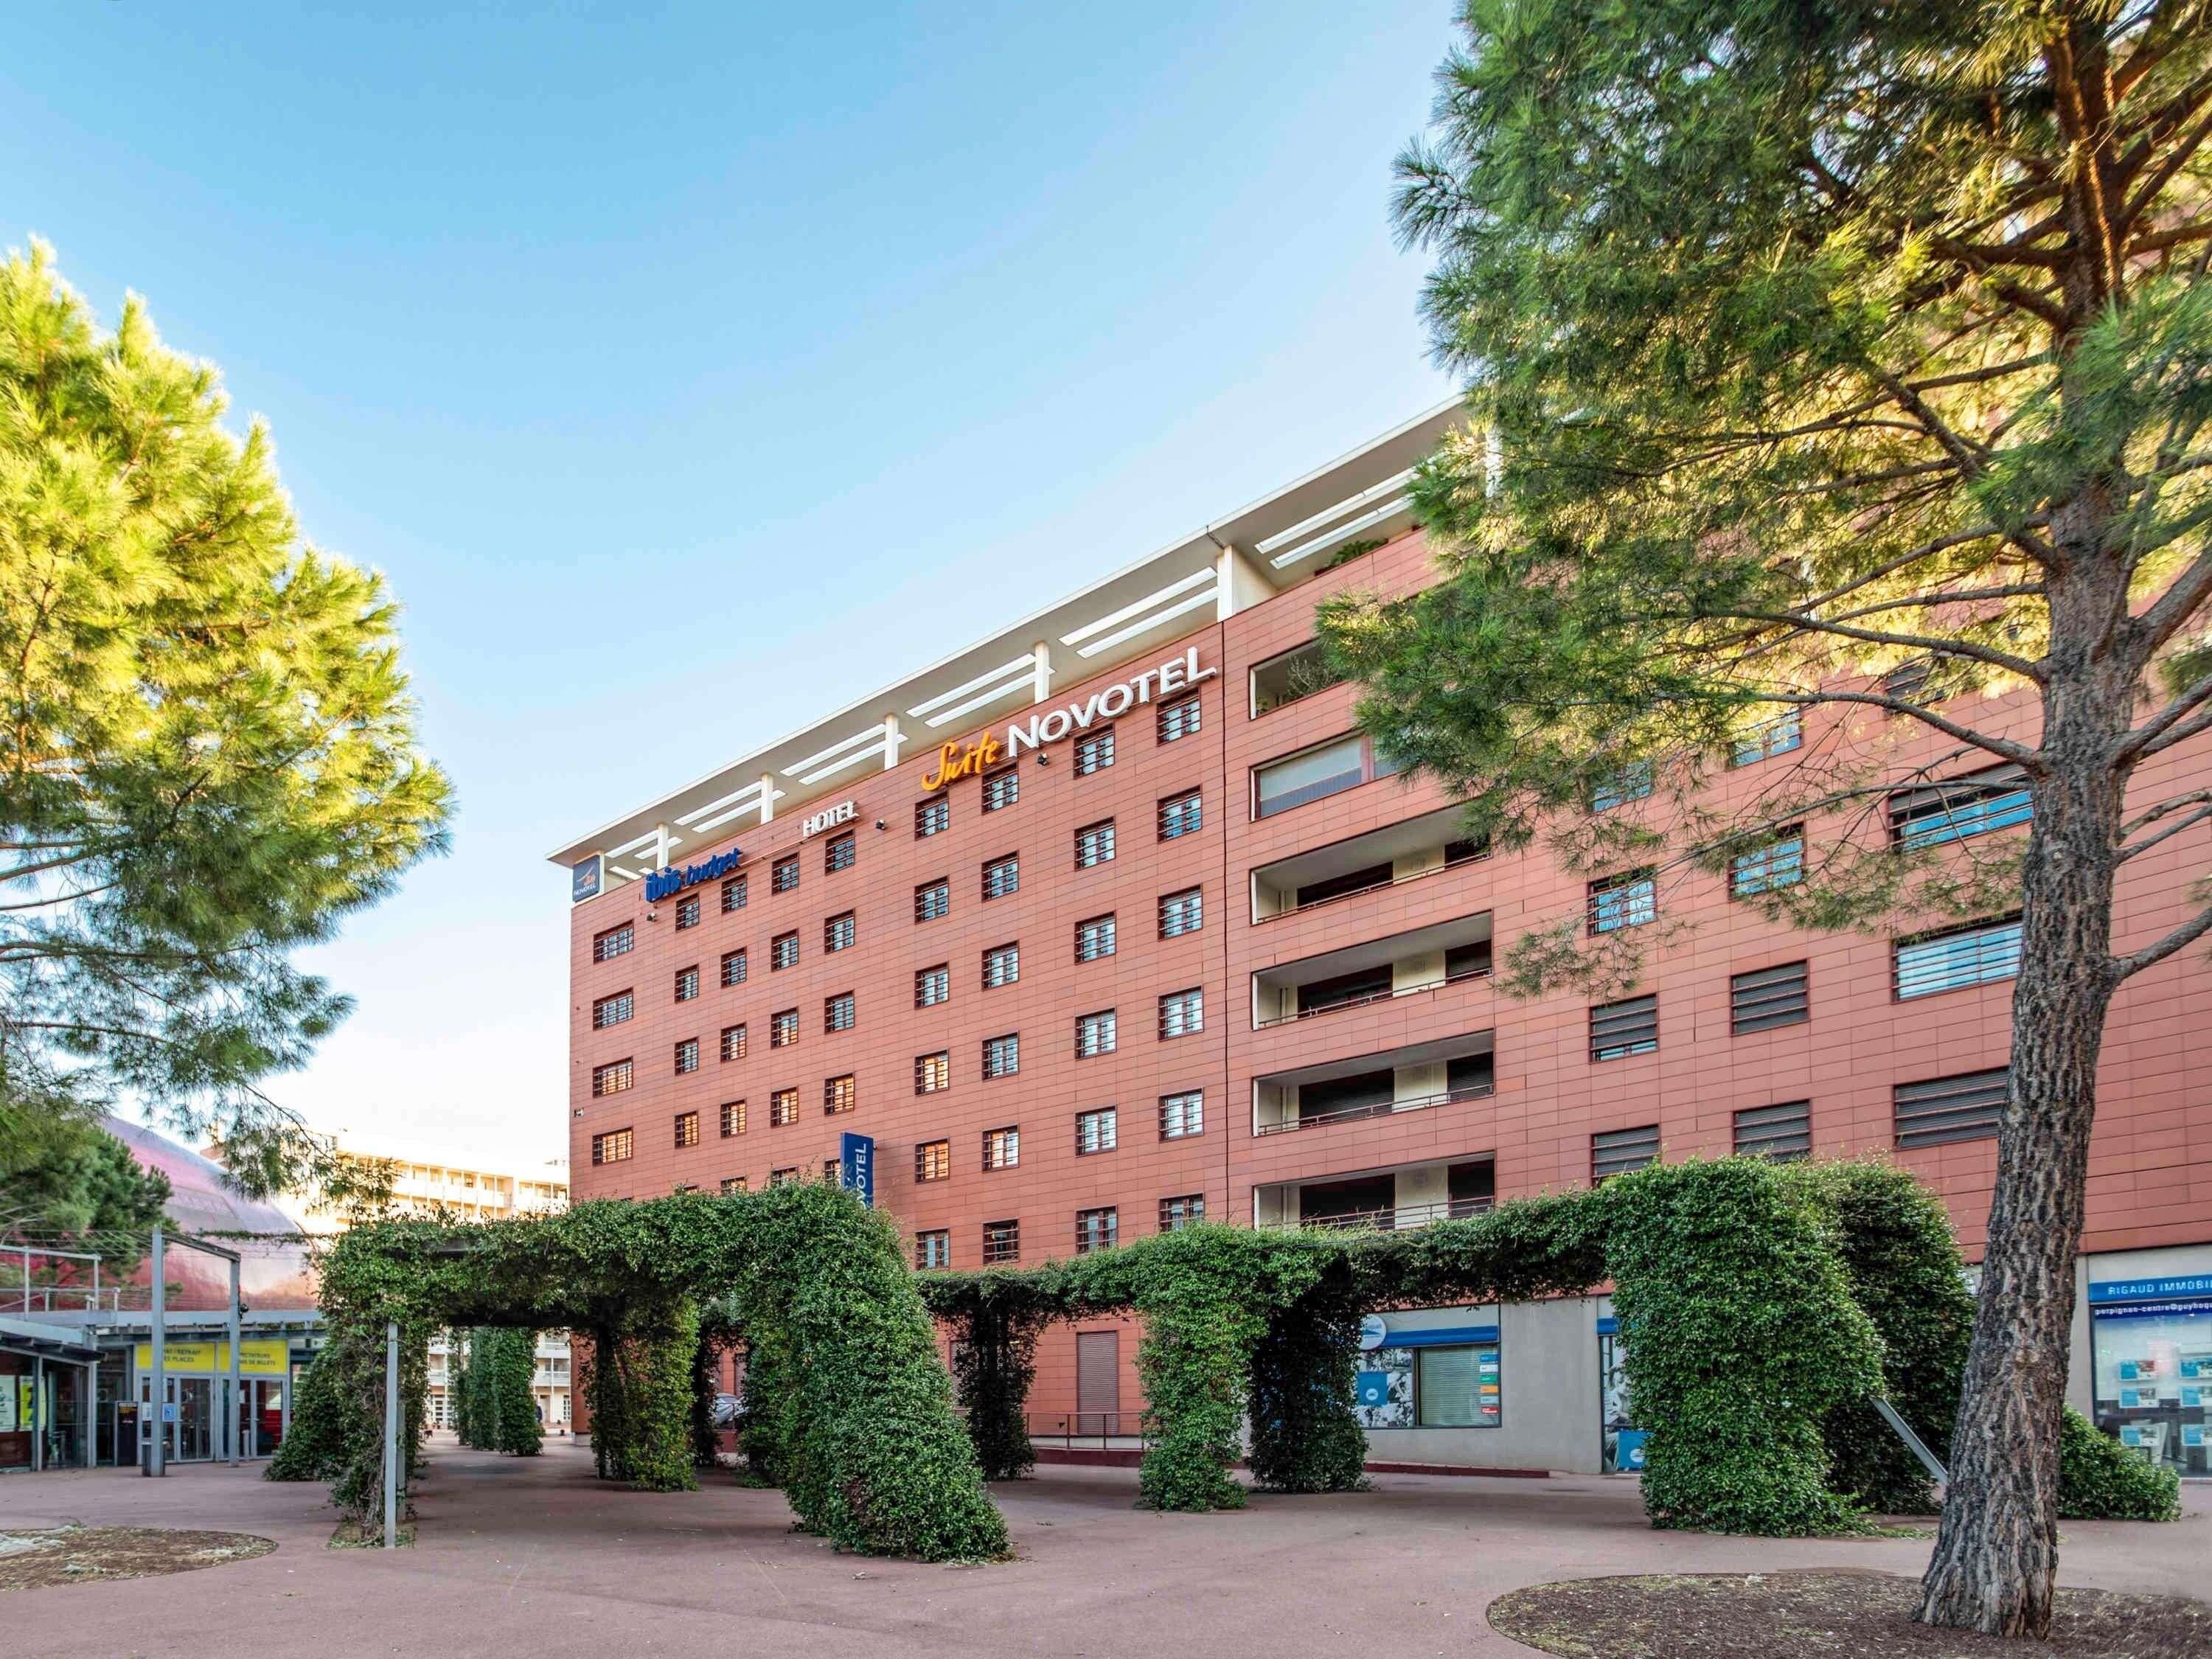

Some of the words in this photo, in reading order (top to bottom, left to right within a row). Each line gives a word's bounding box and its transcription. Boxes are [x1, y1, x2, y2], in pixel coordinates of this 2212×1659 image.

[920, 731, 1001, 792] Suite
[1008, 646, 1217, 759] NOVOTEL
[802, 801, 860, 838] HOTEL
[573, 883, 597, 896] NOVOTEL
[646, 866, 683, 903] ibis
[685, 847, 743, 886] budget
[2107, 1284, 2155, 1295] RIGAUD
